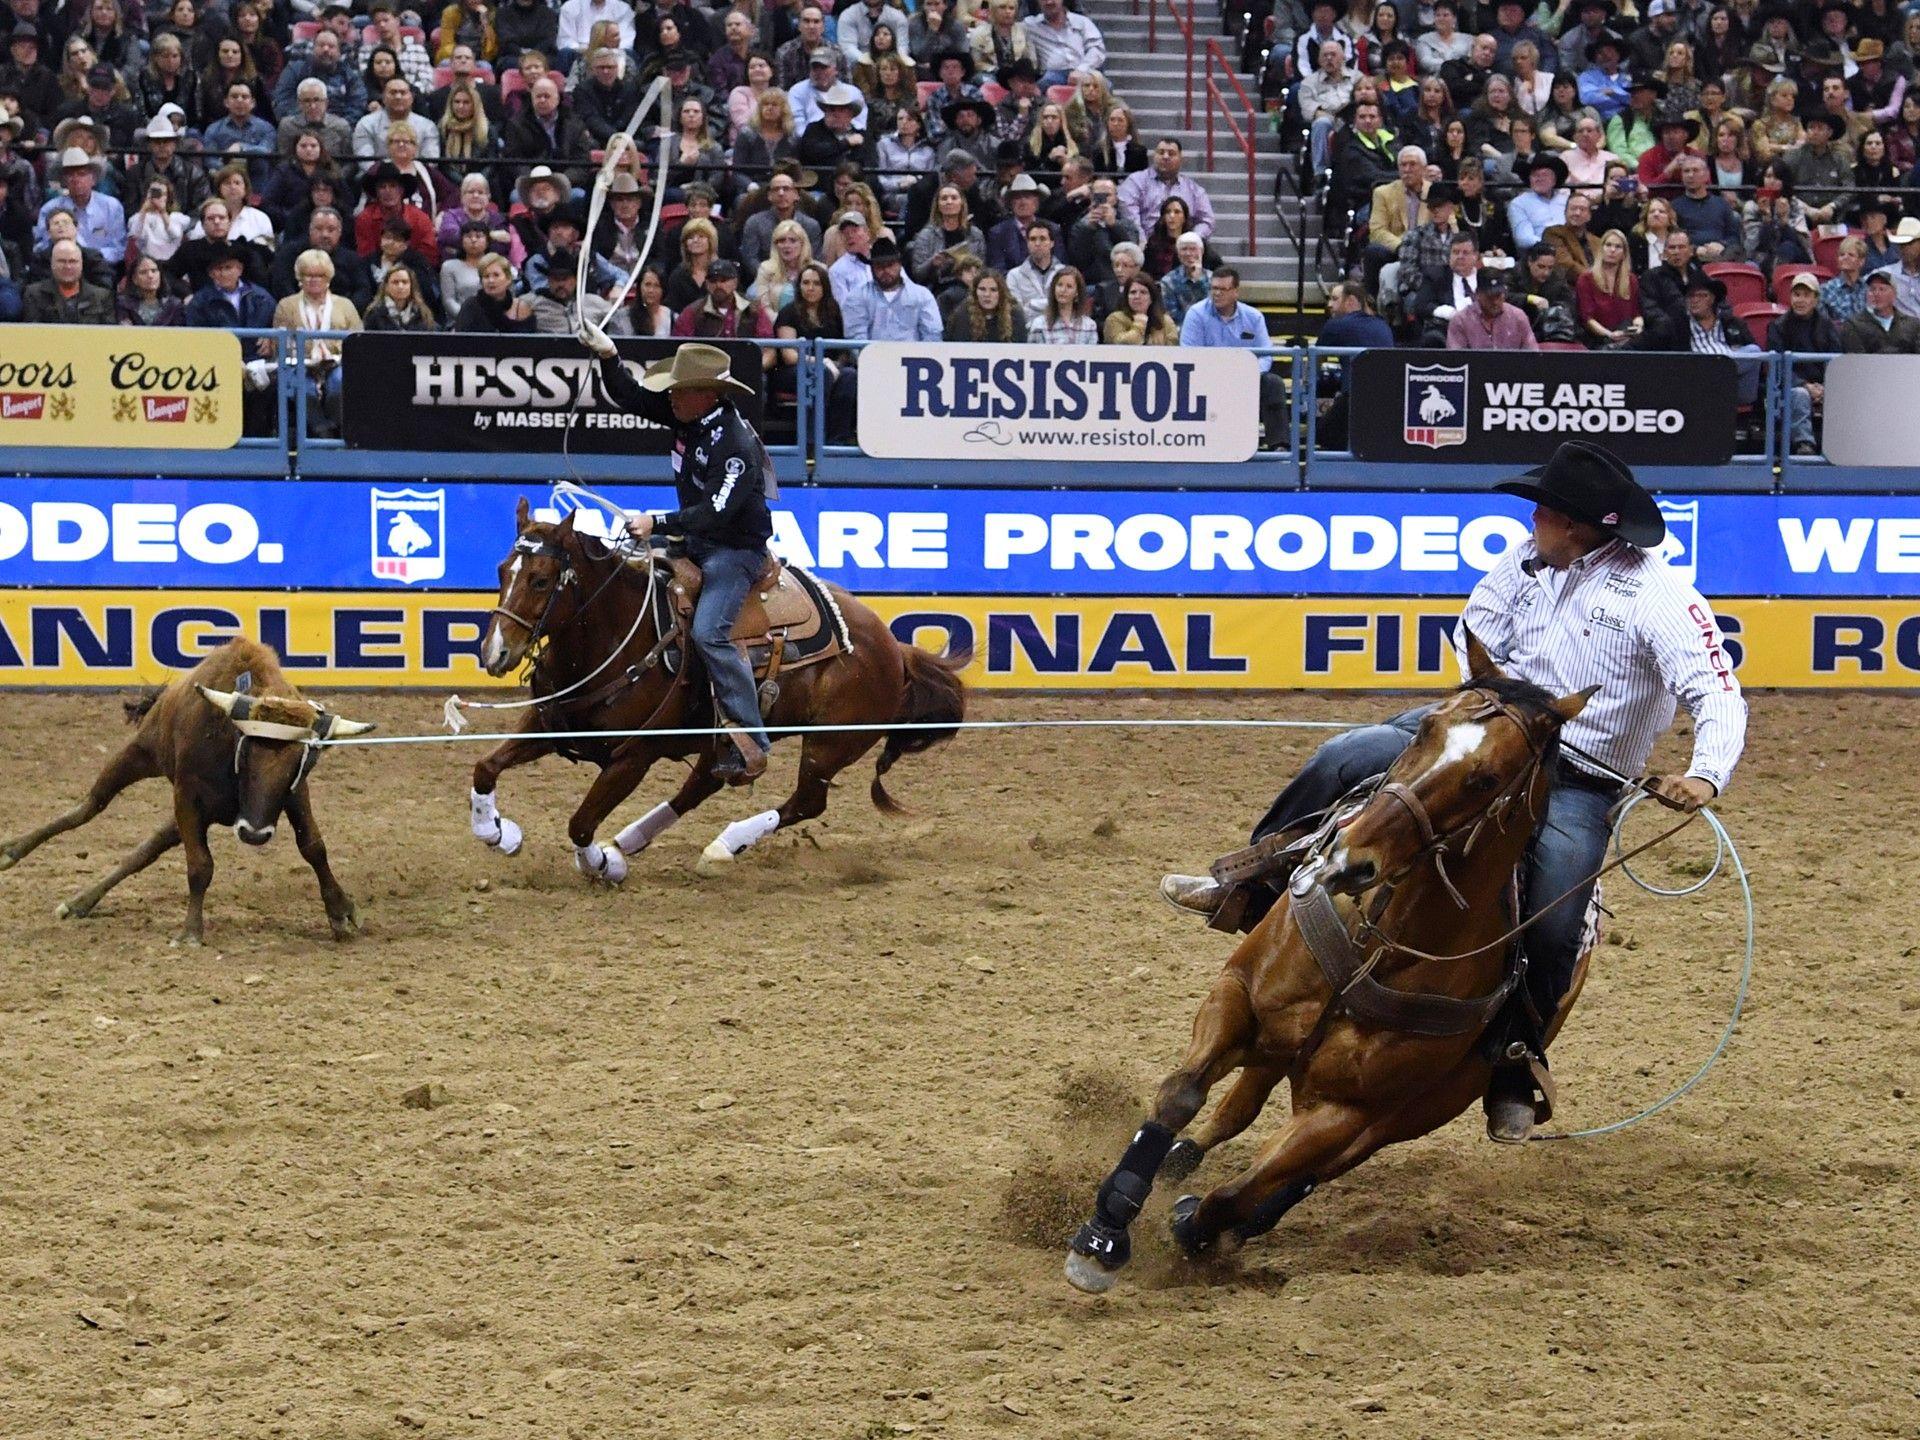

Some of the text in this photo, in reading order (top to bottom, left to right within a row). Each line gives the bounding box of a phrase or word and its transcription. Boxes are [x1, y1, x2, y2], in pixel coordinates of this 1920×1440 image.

[0, 360, 76, 388] oors
[109, 352, 219, 391] Coors
[412, 355, 659, 408] HESST
[901, 357, 1207, 422] RESISTOL
[1484, 382, 1626, 408] WE ARE
[473, 411, 671, 431] by MASSEY FERGU
[1019, 428, 1206, 447] www.resistol.com
[1482, 407, 1685, 434] PRORODEO
[984, 513, 1531, 572] PRORODEO
[1777, 517, 1920, 574] WE
[1591, 606, 1625, 629] Classic
[0, 607, 486, 669] NGLER
[889, 613, 1247, 672] ONAL
[1812, 615, 1920, 672] R
[1688, 603, 1734, 693] CINCH
